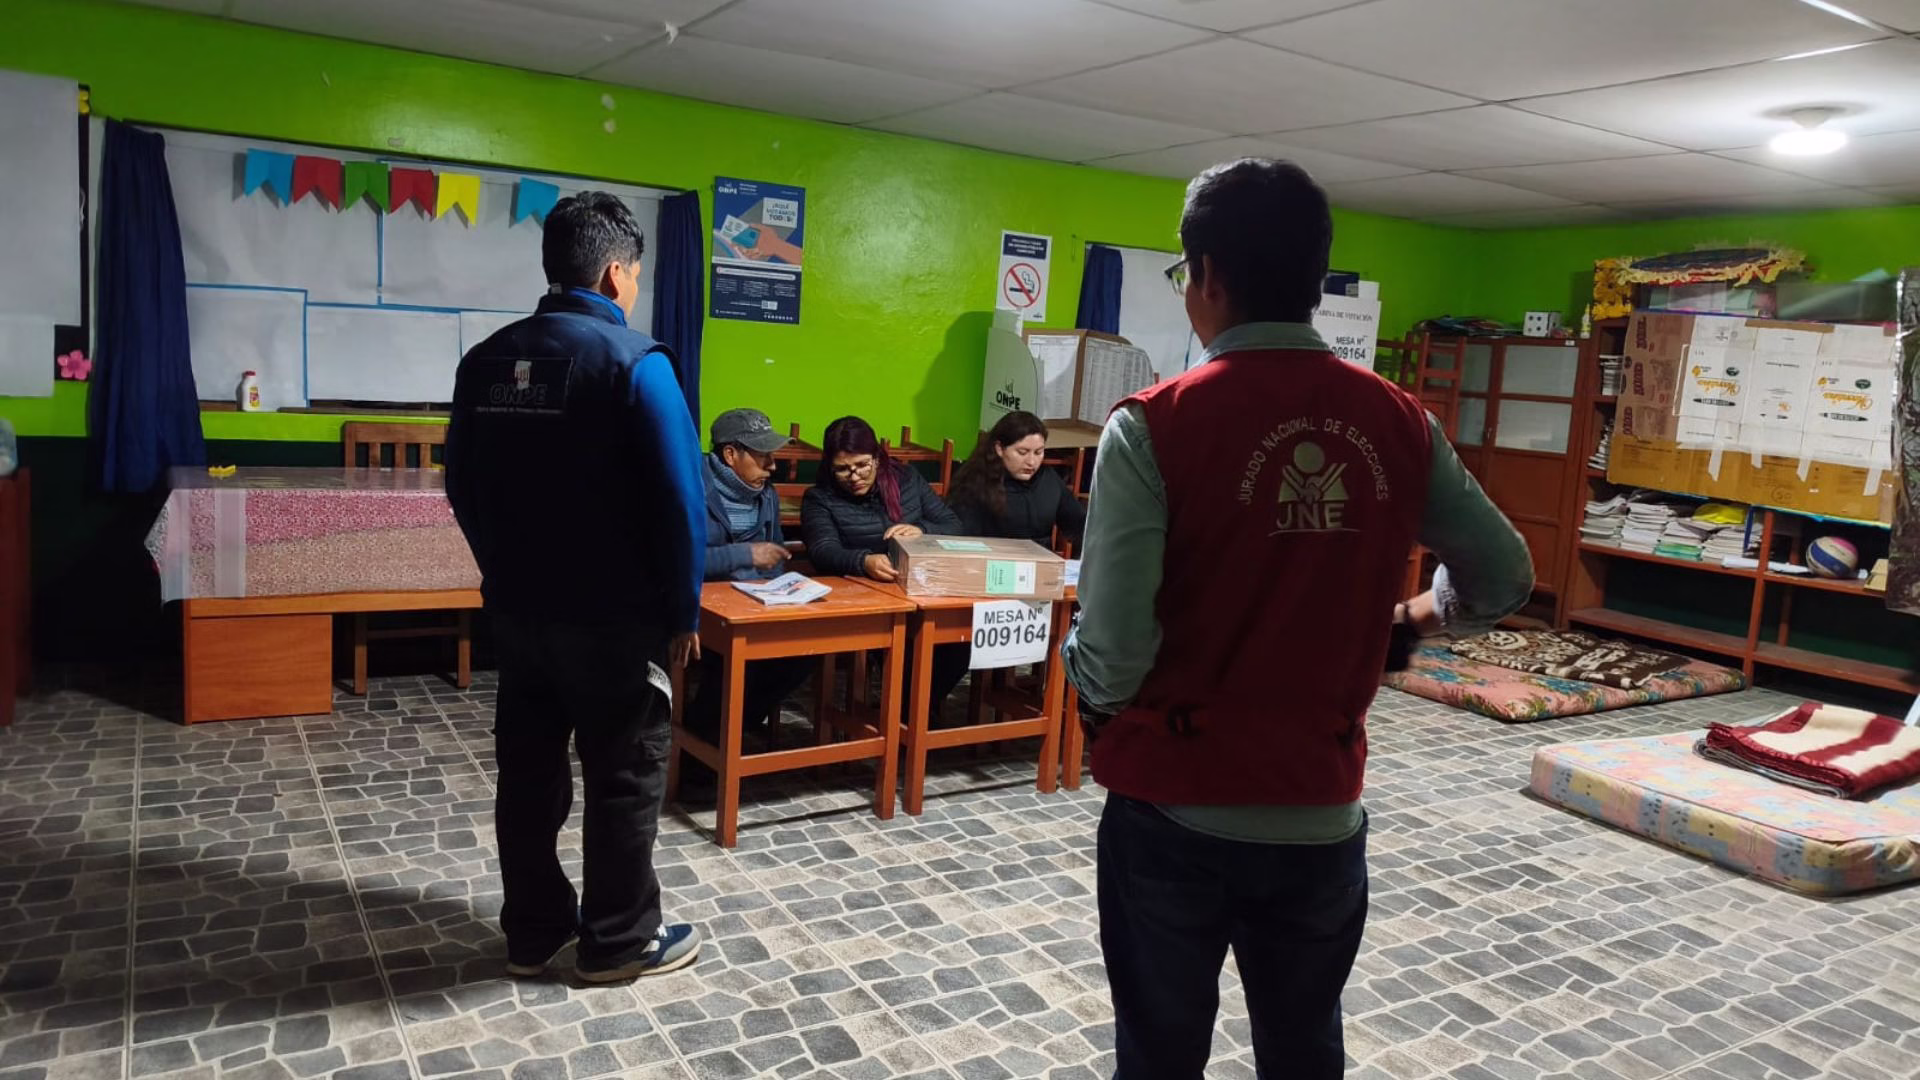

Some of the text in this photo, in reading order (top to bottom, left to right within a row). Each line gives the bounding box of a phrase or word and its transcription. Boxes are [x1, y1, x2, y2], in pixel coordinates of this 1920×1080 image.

[1336, 336, 1355, 345] MESA
[490, 383, 548, 405] ONPE
[996, 391, 1020, 410] ONPE
[1238, 416, 1389, 505] JURADO NACIONAL DE ELECCIONES
[1276, 503, 1345, 529] JNE
[984, 609, 1024, 624] MESA
[974, 623, 1047, 649] 009164
